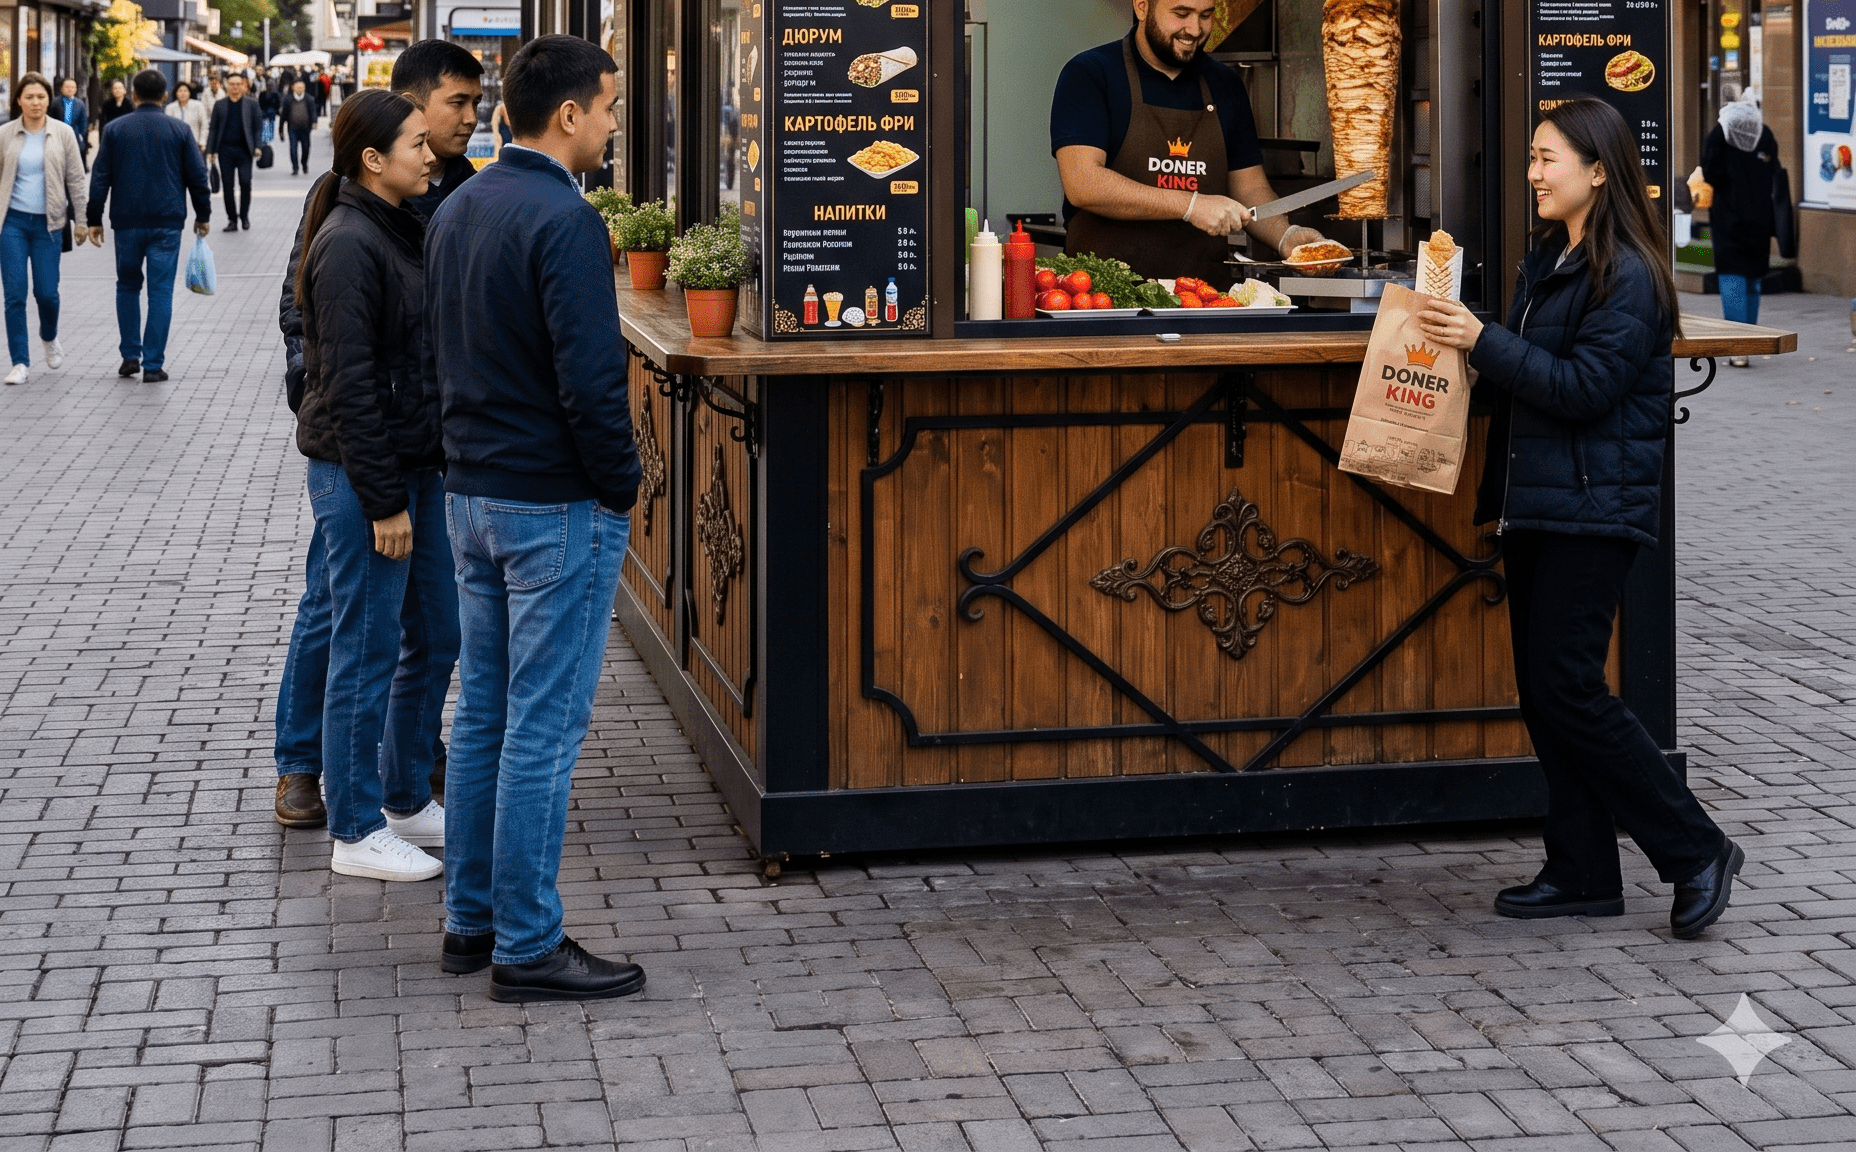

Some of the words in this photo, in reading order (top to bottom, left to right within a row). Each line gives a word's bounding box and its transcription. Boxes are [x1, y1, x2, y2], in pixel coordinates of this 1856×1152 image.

[782, 28, 843, 46] ДЮРУМ
[1538, 33, 1605, 47] КАРТОФЕЛЬ
[1606, 34, 1632, 47] ФРИ
[784, 114, 877, 133] КАРТОФЕЛЬ
[880, 114, 914, 132] ФРИ
[1148, 157, 1207, 176] DONER
[1157, 175, 1199, 191] KING
[814, 204, 886, 221] НАПИТКИ
[1381, 364, 1450, 395] DONER
[1386, 384, 1436, 410] KING
